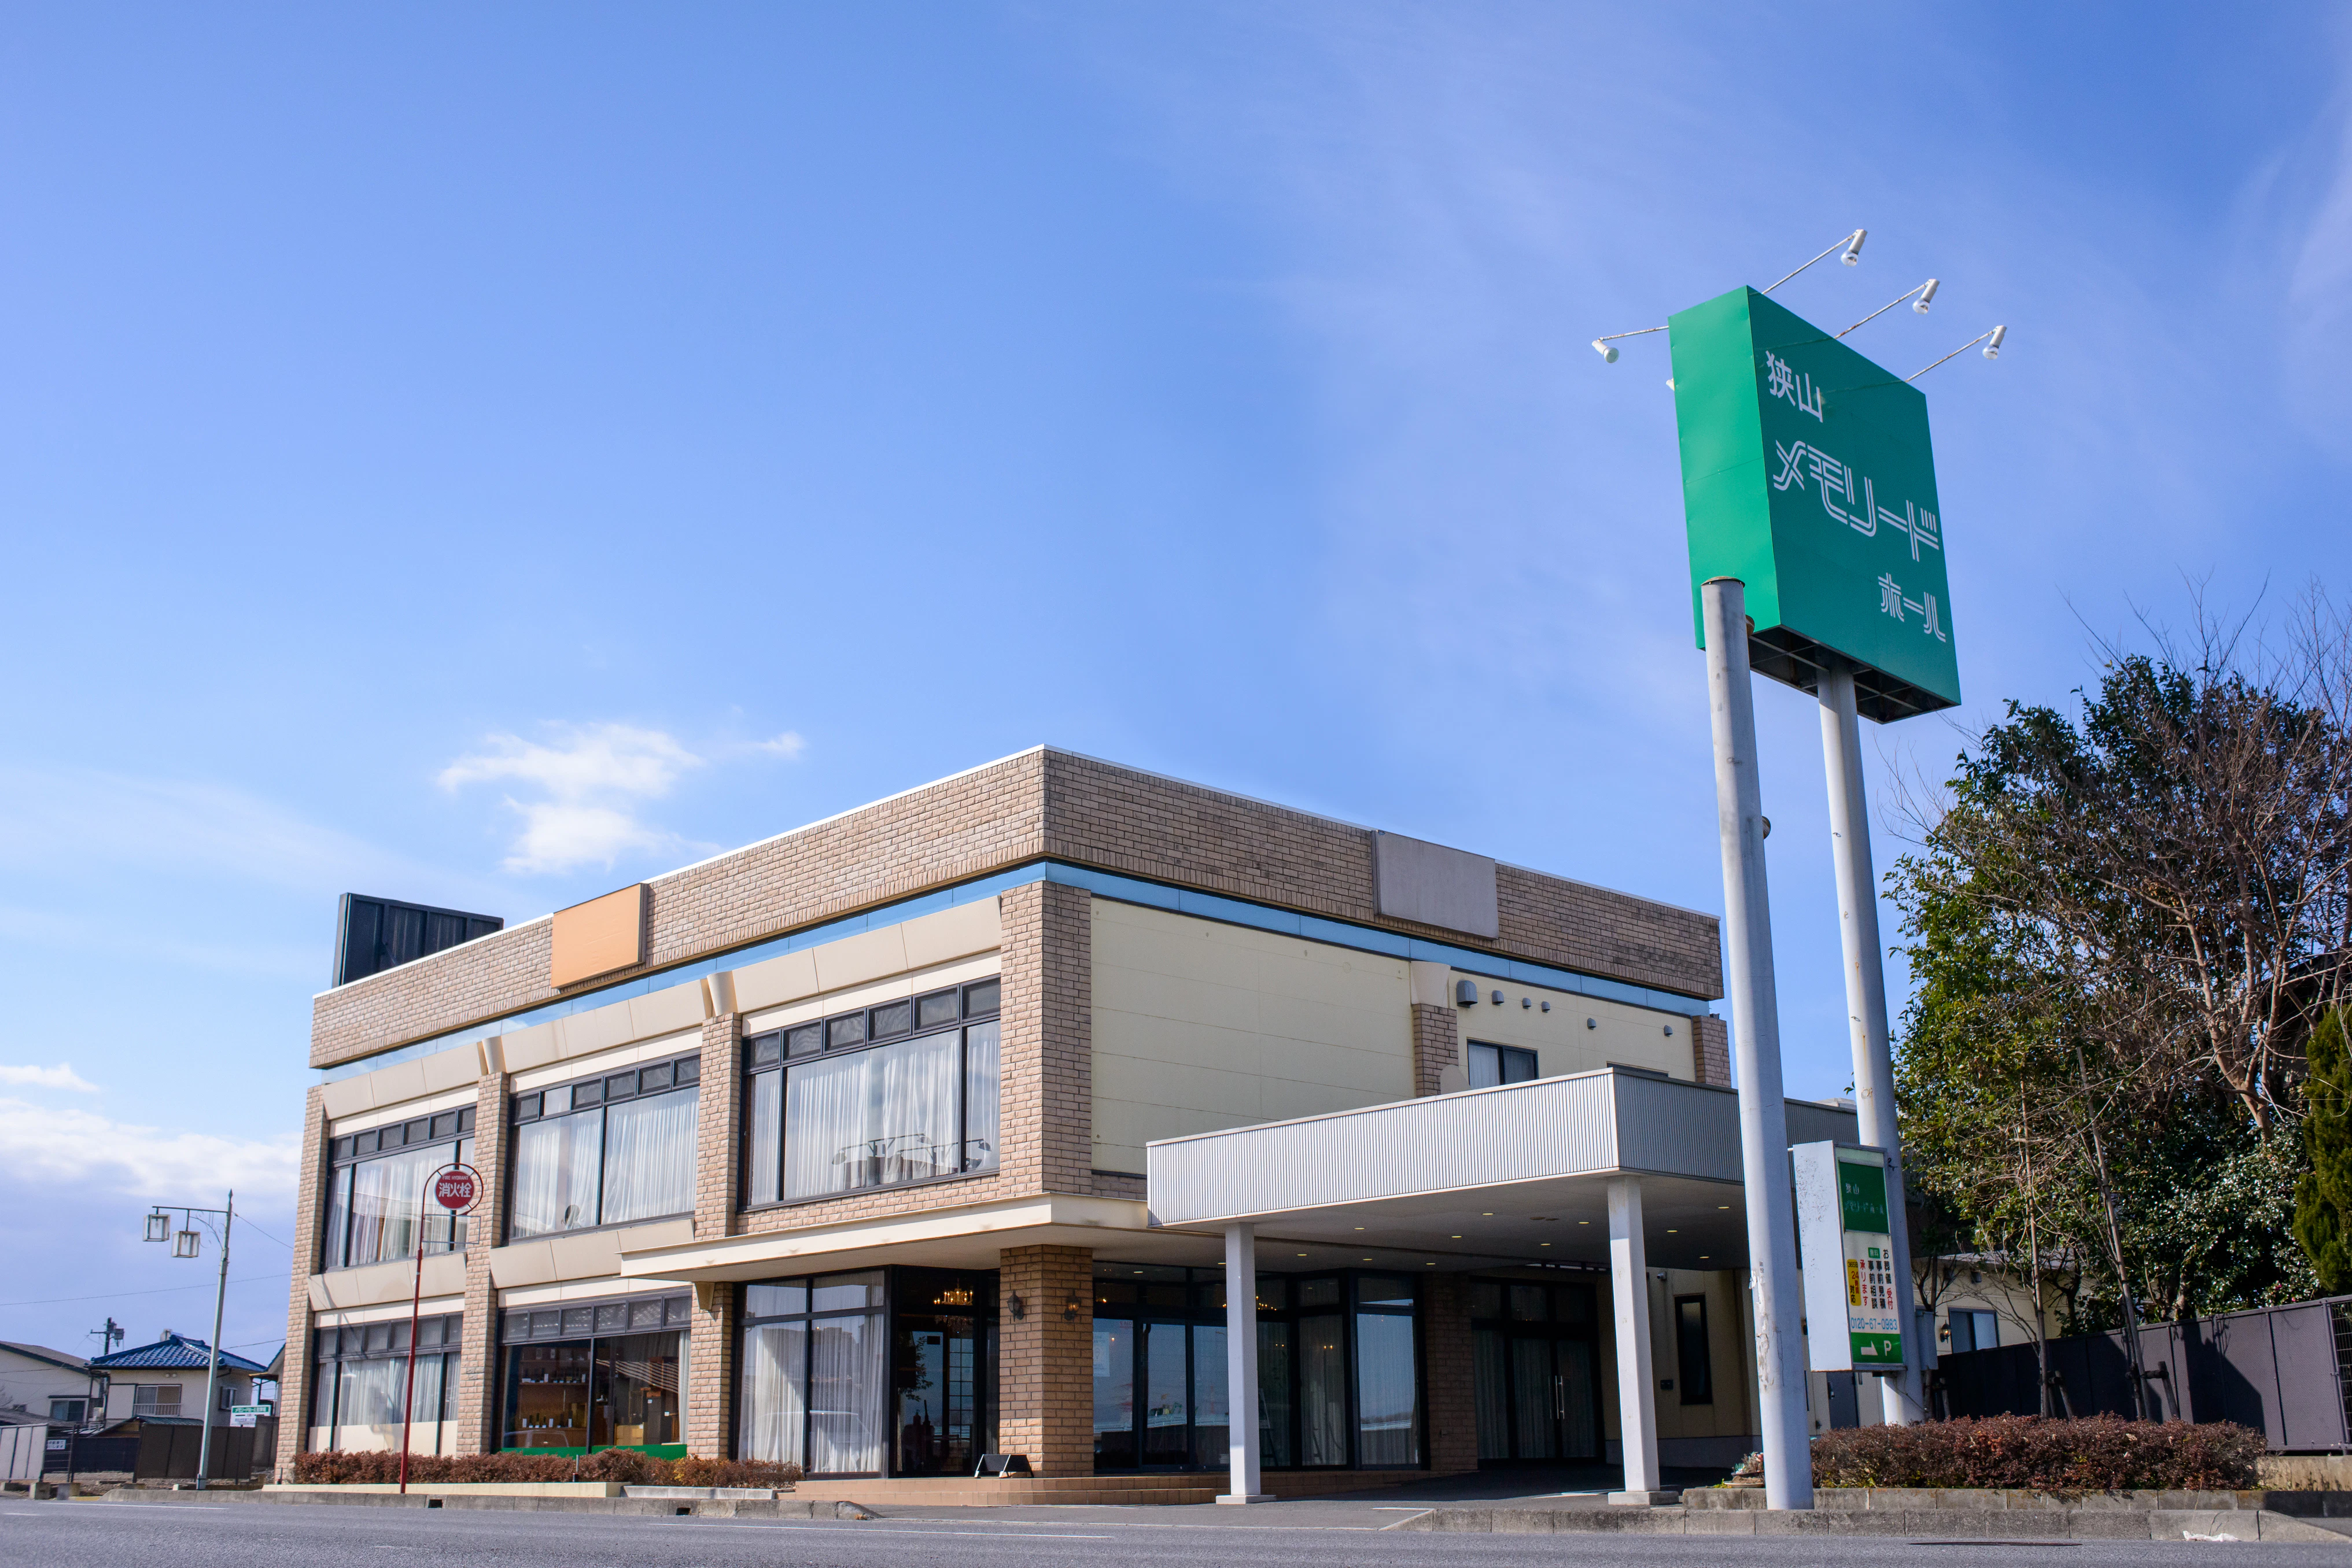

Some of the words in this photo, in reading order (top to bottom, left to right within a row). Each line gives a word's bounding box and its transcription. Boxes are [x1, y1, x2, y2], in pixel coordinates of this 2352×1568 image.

[1766, 350, 1823, 423] 狭山
[1773, 440, 1939, 562] メモリード
[1878, 572, 1946, 643] ホール
[438, 1182, 472, 1198] 消火栓
[1860, 1259, 1868, 1306] 承ります
[1868, 1260, 1878, 1309] 事前相談
[1876, 1260, 1886, 1309] 事前見積
[1883, 1249, 1892, 1283] お葬儀
[1887, 1287, 1893, 1310] 受付
[1851, 1317, 1897, 1330] 0120-67-0983
[1883, 1340, 1892, 1356] P
